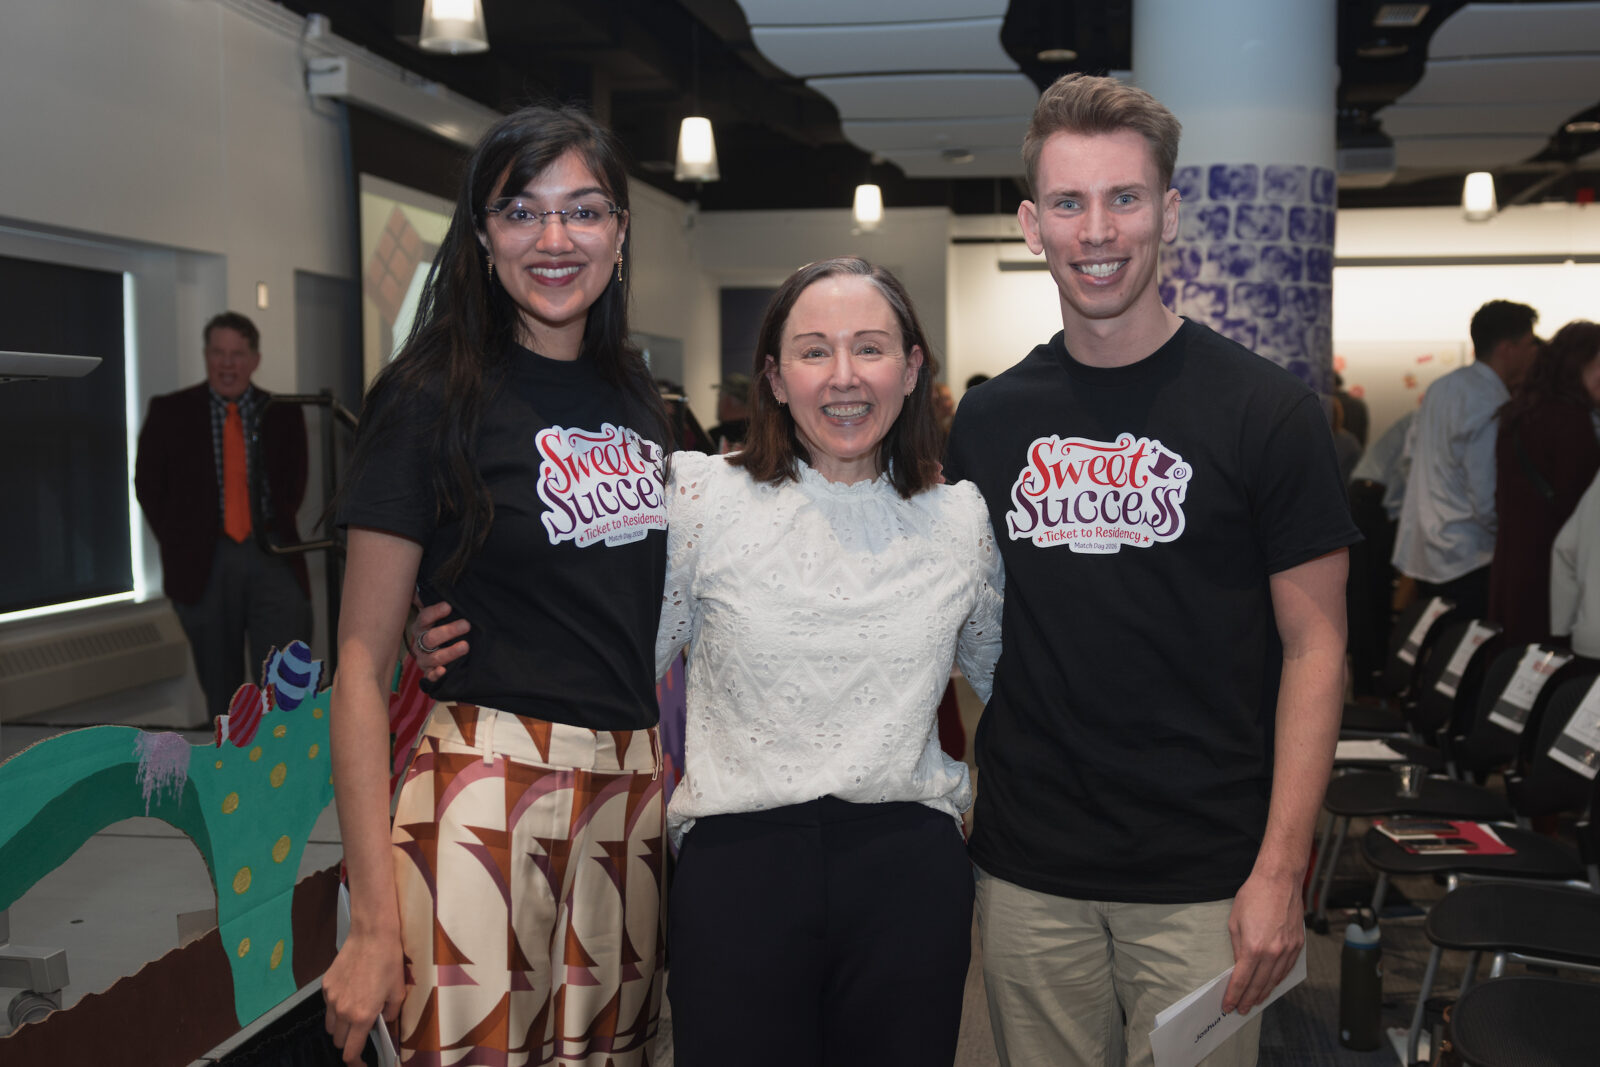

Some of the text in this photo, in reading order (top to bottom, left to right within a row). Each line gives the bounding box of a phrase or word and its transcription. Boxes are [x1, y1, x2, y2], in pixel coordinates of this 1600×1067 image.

[541, 430, 646, 493] Sweet
[1022, 439, 1148, 496] Sweet
[544, 469, 666, 538] Succe
[584, 512, 664, 540] Ticket to Residency
[1011, 477, 1182, 537] Success
[1043, 526, 1141, 543] Ticket to Residency
[1093, 542, 1104, 550] Day
